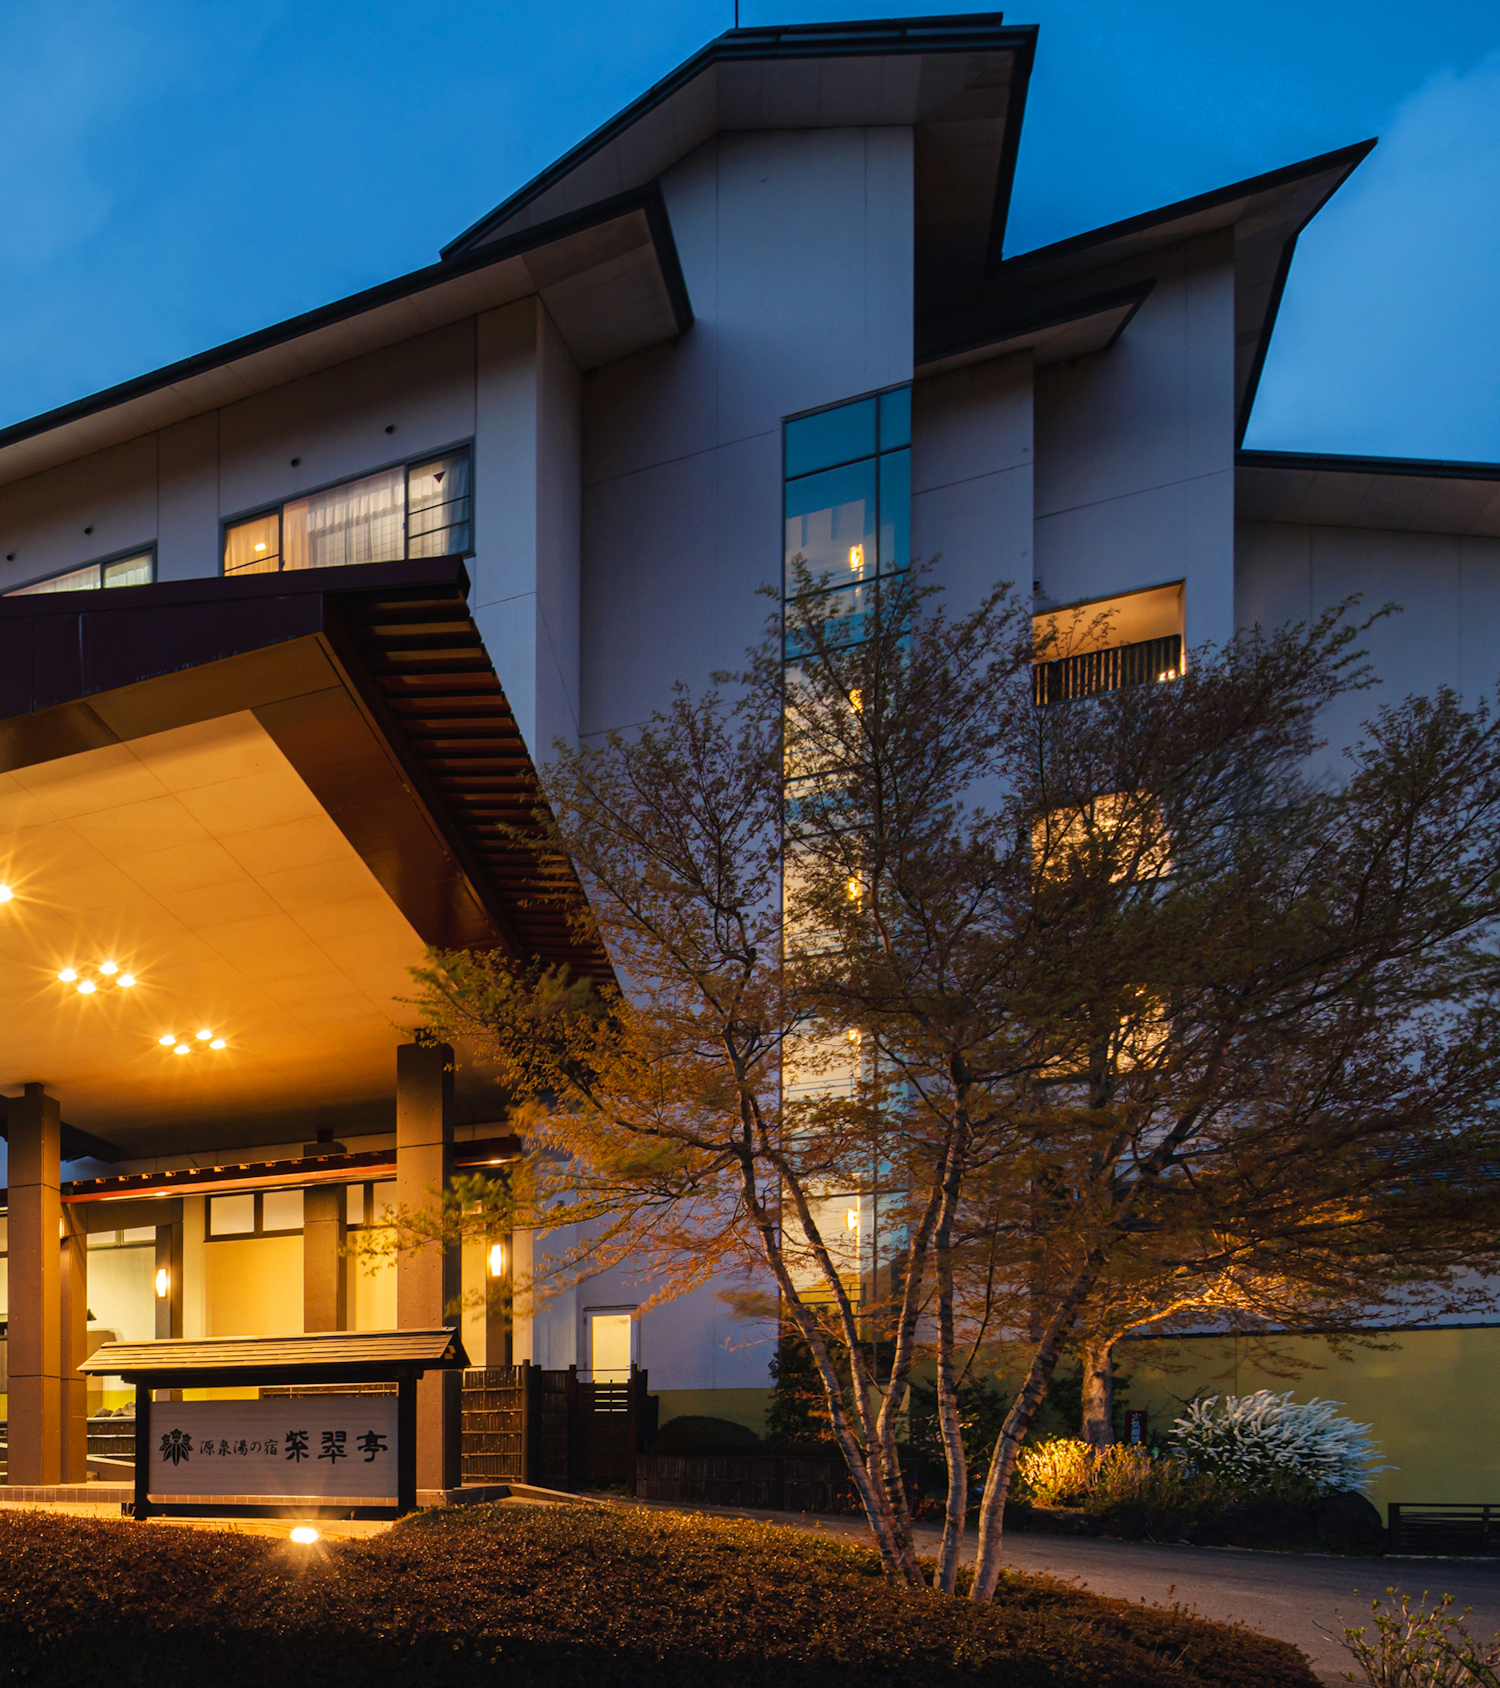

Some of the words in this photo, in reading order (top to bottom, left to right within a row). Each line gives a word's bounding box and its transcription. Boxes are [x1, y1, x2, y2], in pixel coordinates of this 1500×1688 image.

[200, 1438, 279, 1456] 源泉湯の宿
[284, 1430, 388, 1465] 紫翠亭
